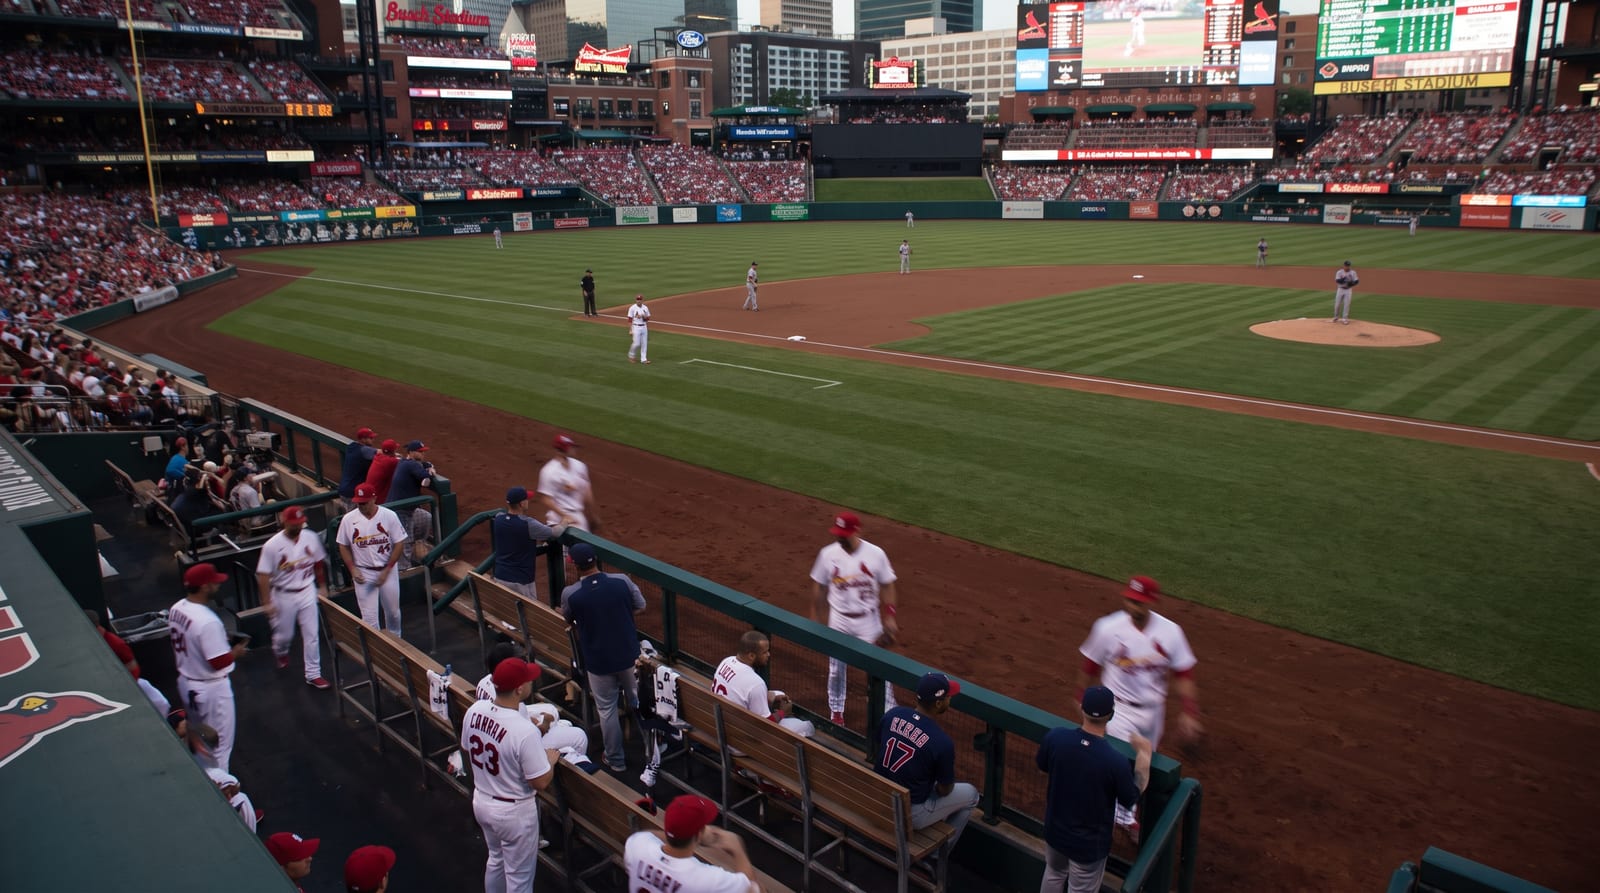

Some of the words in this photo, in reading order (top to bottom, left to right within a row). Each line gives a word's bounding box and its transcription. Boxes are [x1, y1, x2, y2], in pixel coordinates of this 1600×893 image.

[386, 1, 430, 23] Busch
[433, 4, 490, 26] Stadium
[1403, 75, 1479, 91] STADIUM
[469, 734, 499, 777] 23
[882, 736, 916, 773] 17
